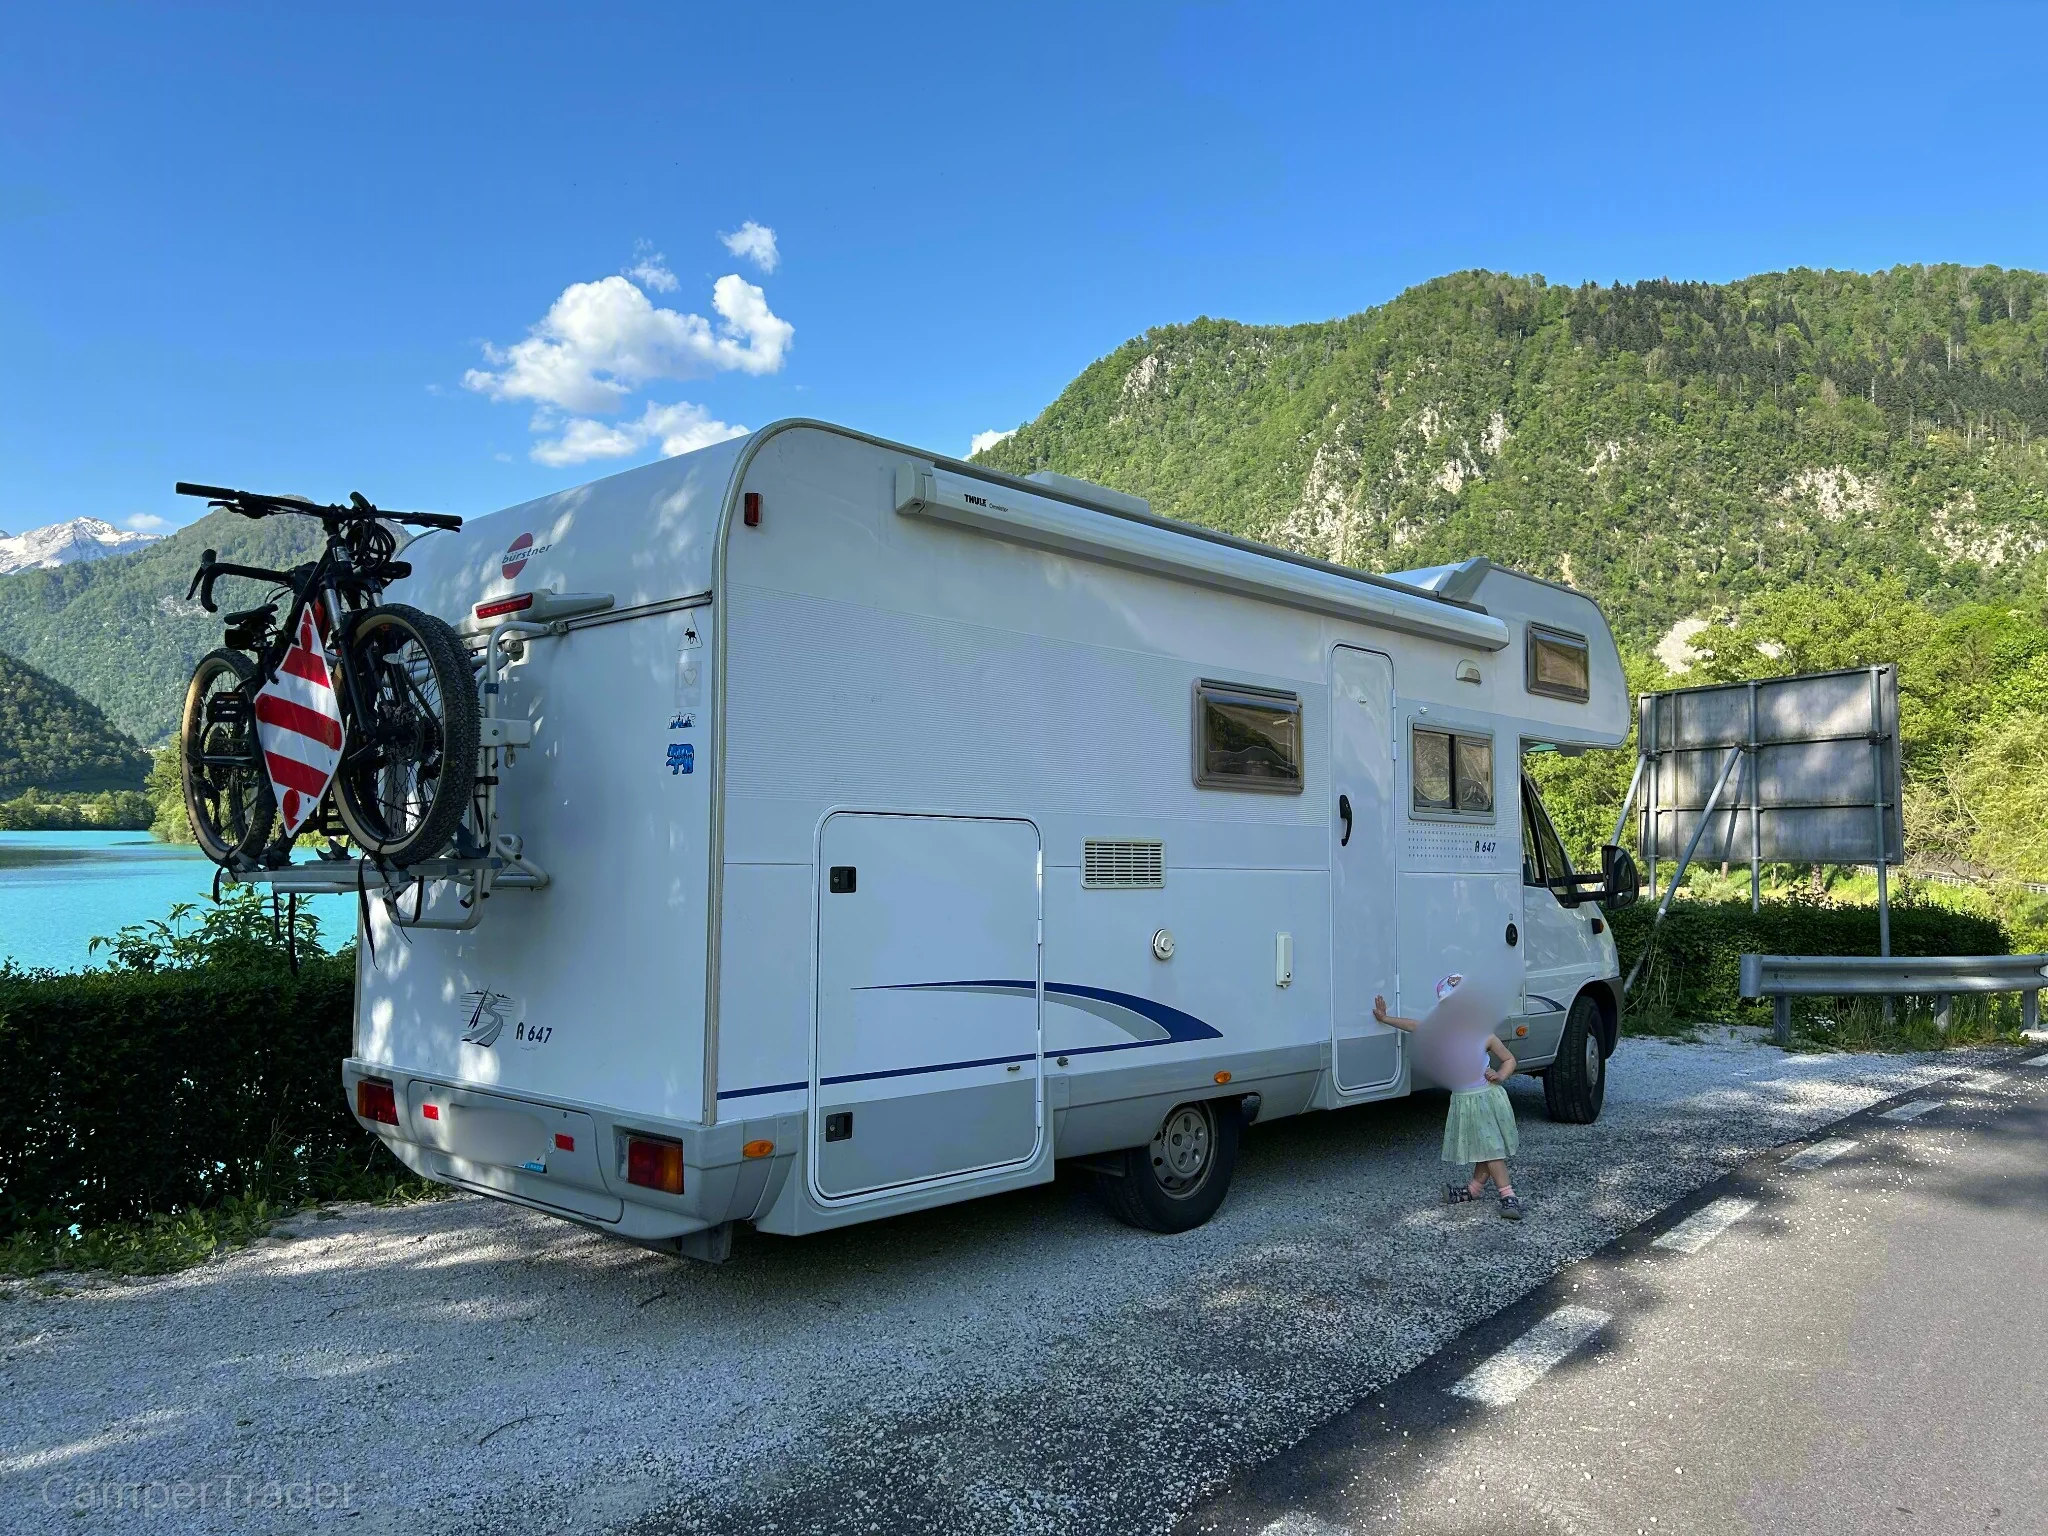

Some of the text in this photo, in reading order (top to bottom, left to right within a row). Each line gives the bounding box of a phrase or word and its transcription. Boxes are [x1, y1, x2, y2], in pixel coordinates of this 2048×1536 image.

[964, 493, 987, 507] THULE
[501, 544, 553, 564] bürstner
[1481, 841, 1497, 853] 647
[527, 1025, 553, 1044] 647
